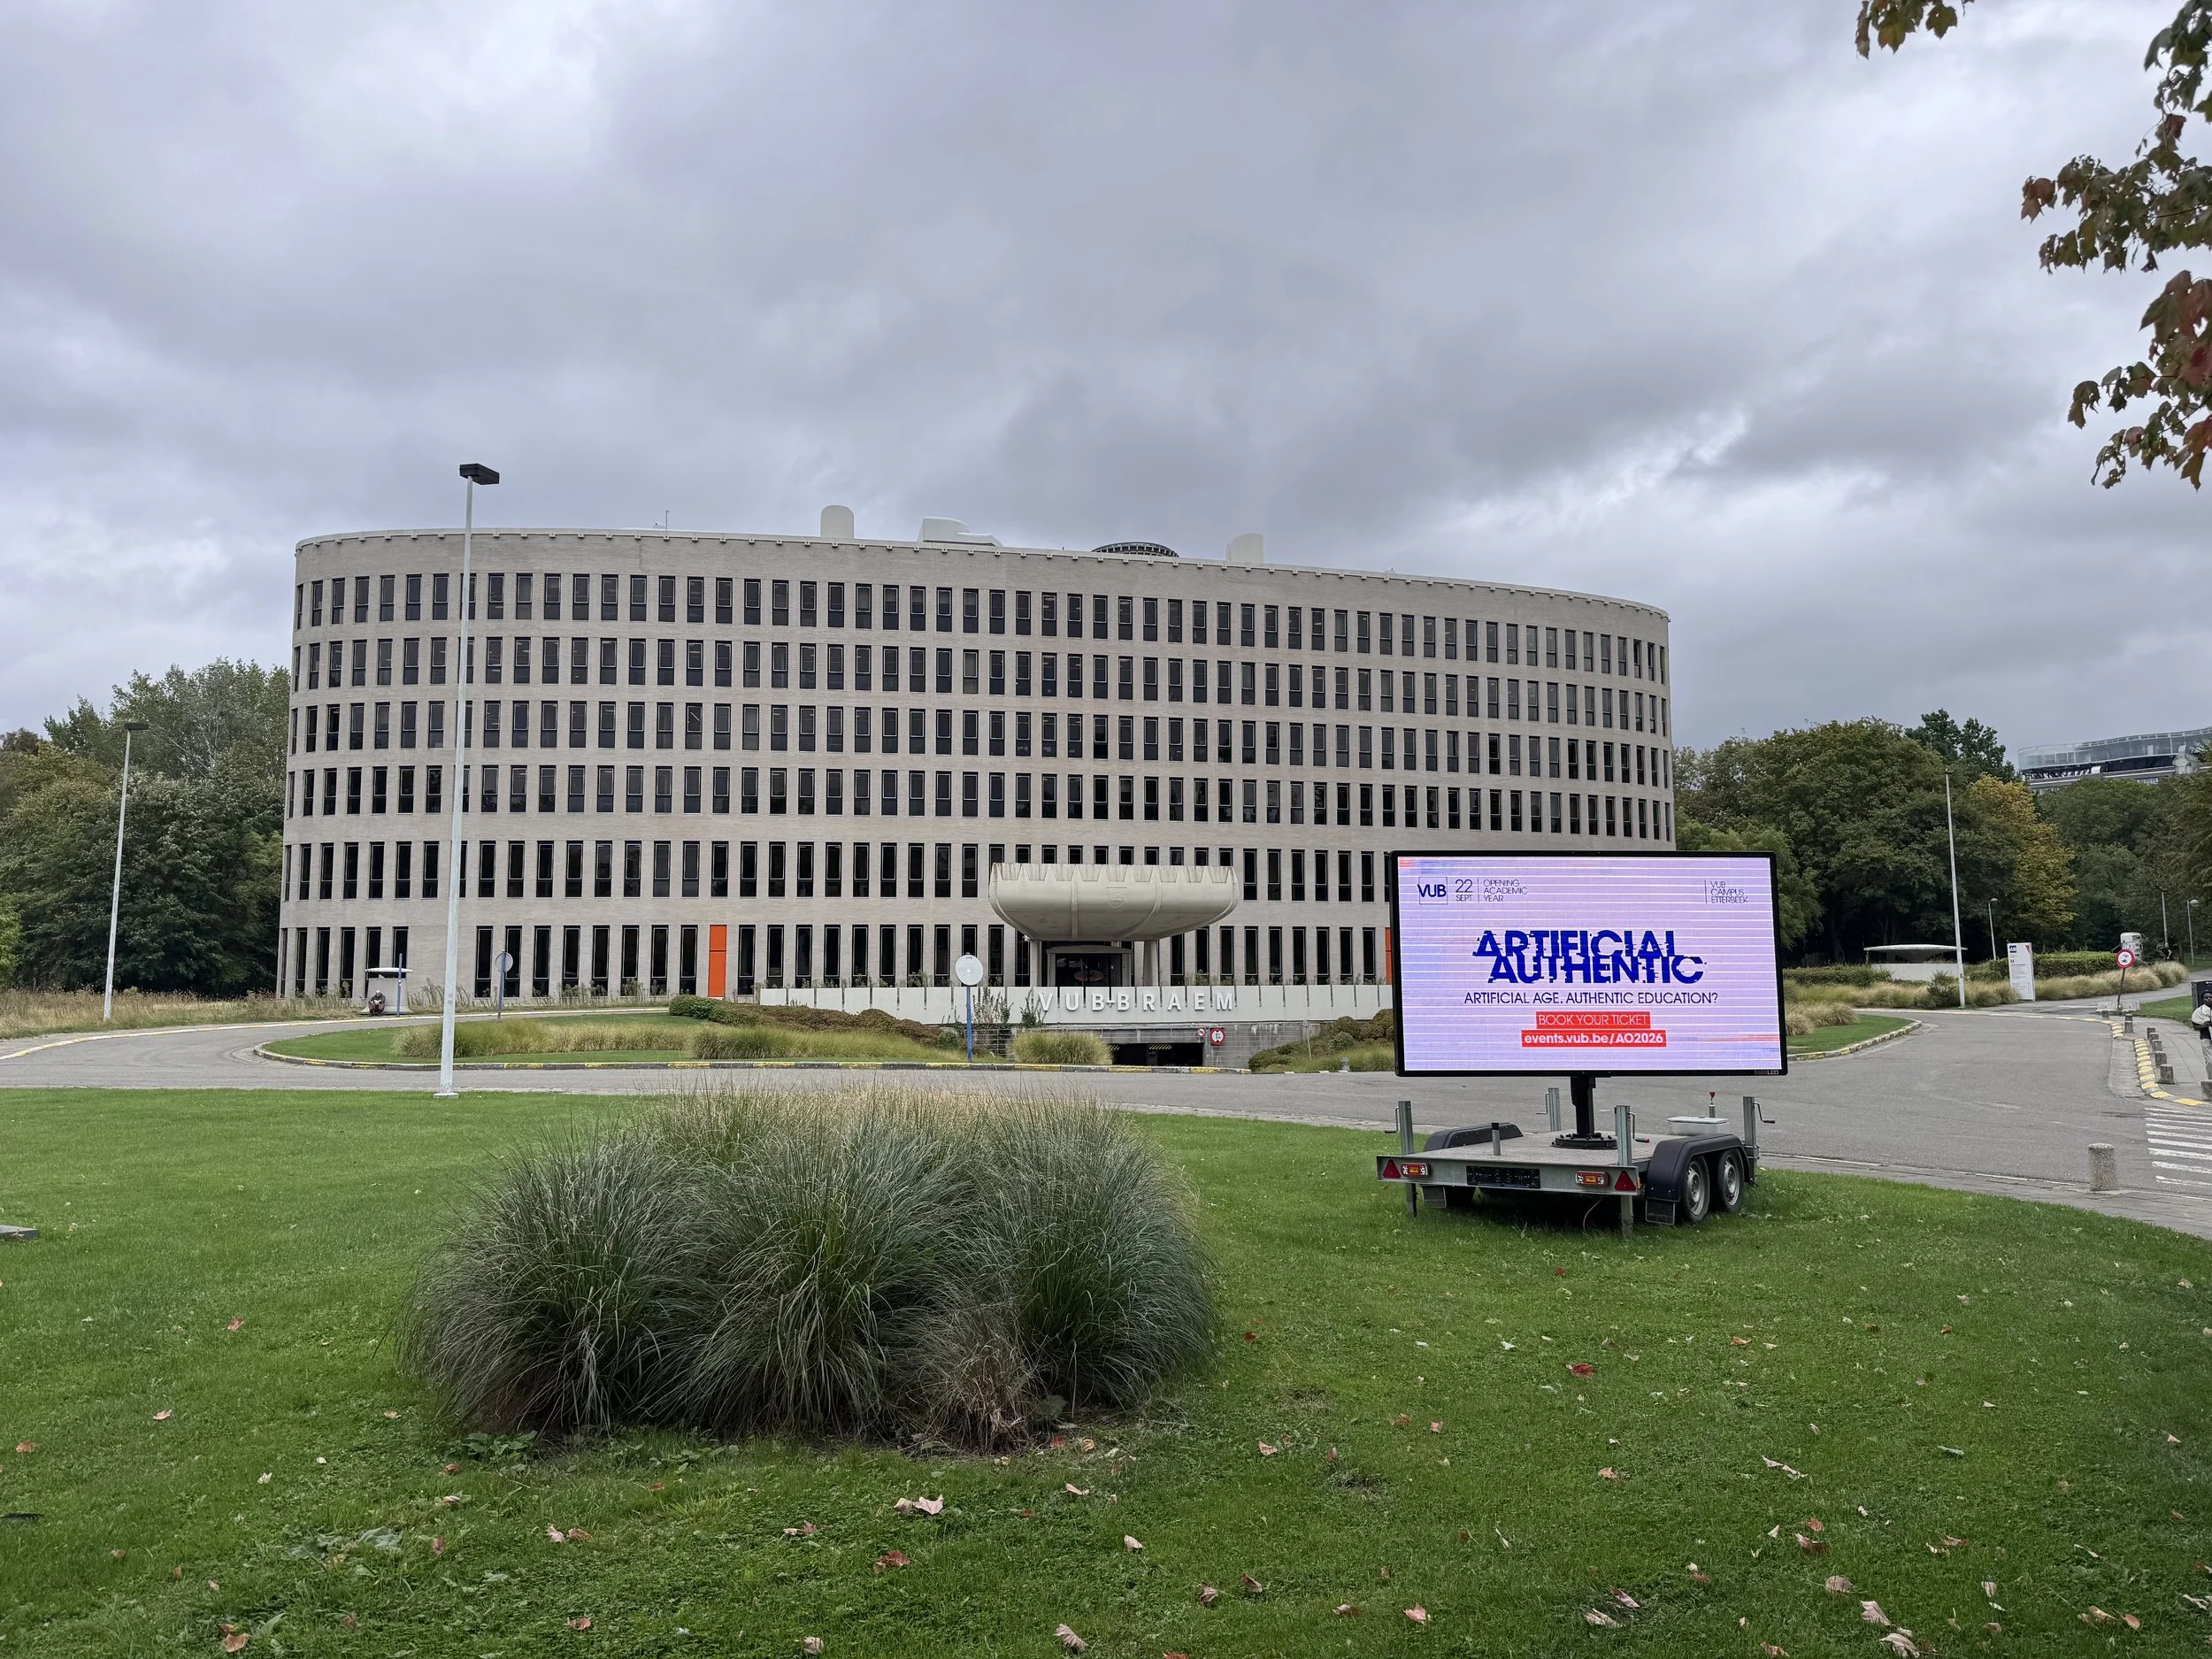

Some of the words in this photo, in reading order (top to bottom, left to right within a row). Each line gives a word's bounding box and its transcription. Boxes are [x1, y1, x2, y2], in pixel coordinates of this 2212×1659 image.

[1417, 884, 1447, 897] VUB
[1455, 879, 1473, 893] 22
[1472, 930, 1681, 957] ARTIFICIAL
[1487, 956, 1705, 984] AUTHENTIC
[1464, 992, 1530, 1004] ARTIFICIAL
[1532, 992, 1563, 1004] AGE.
[1565, 992, 1634, 1004] AUTHENTIC
[1638, 992, 1718, 1004] EDUCATION?
[1539, 1014, 1574, 1025] BOOK
[1576, 1014, 1609, 1025] YOUR
[1611, 1014, 1647, 1025] TICKET
[1524, 1033, 1663, 1045] events.vub.be/AO2026
